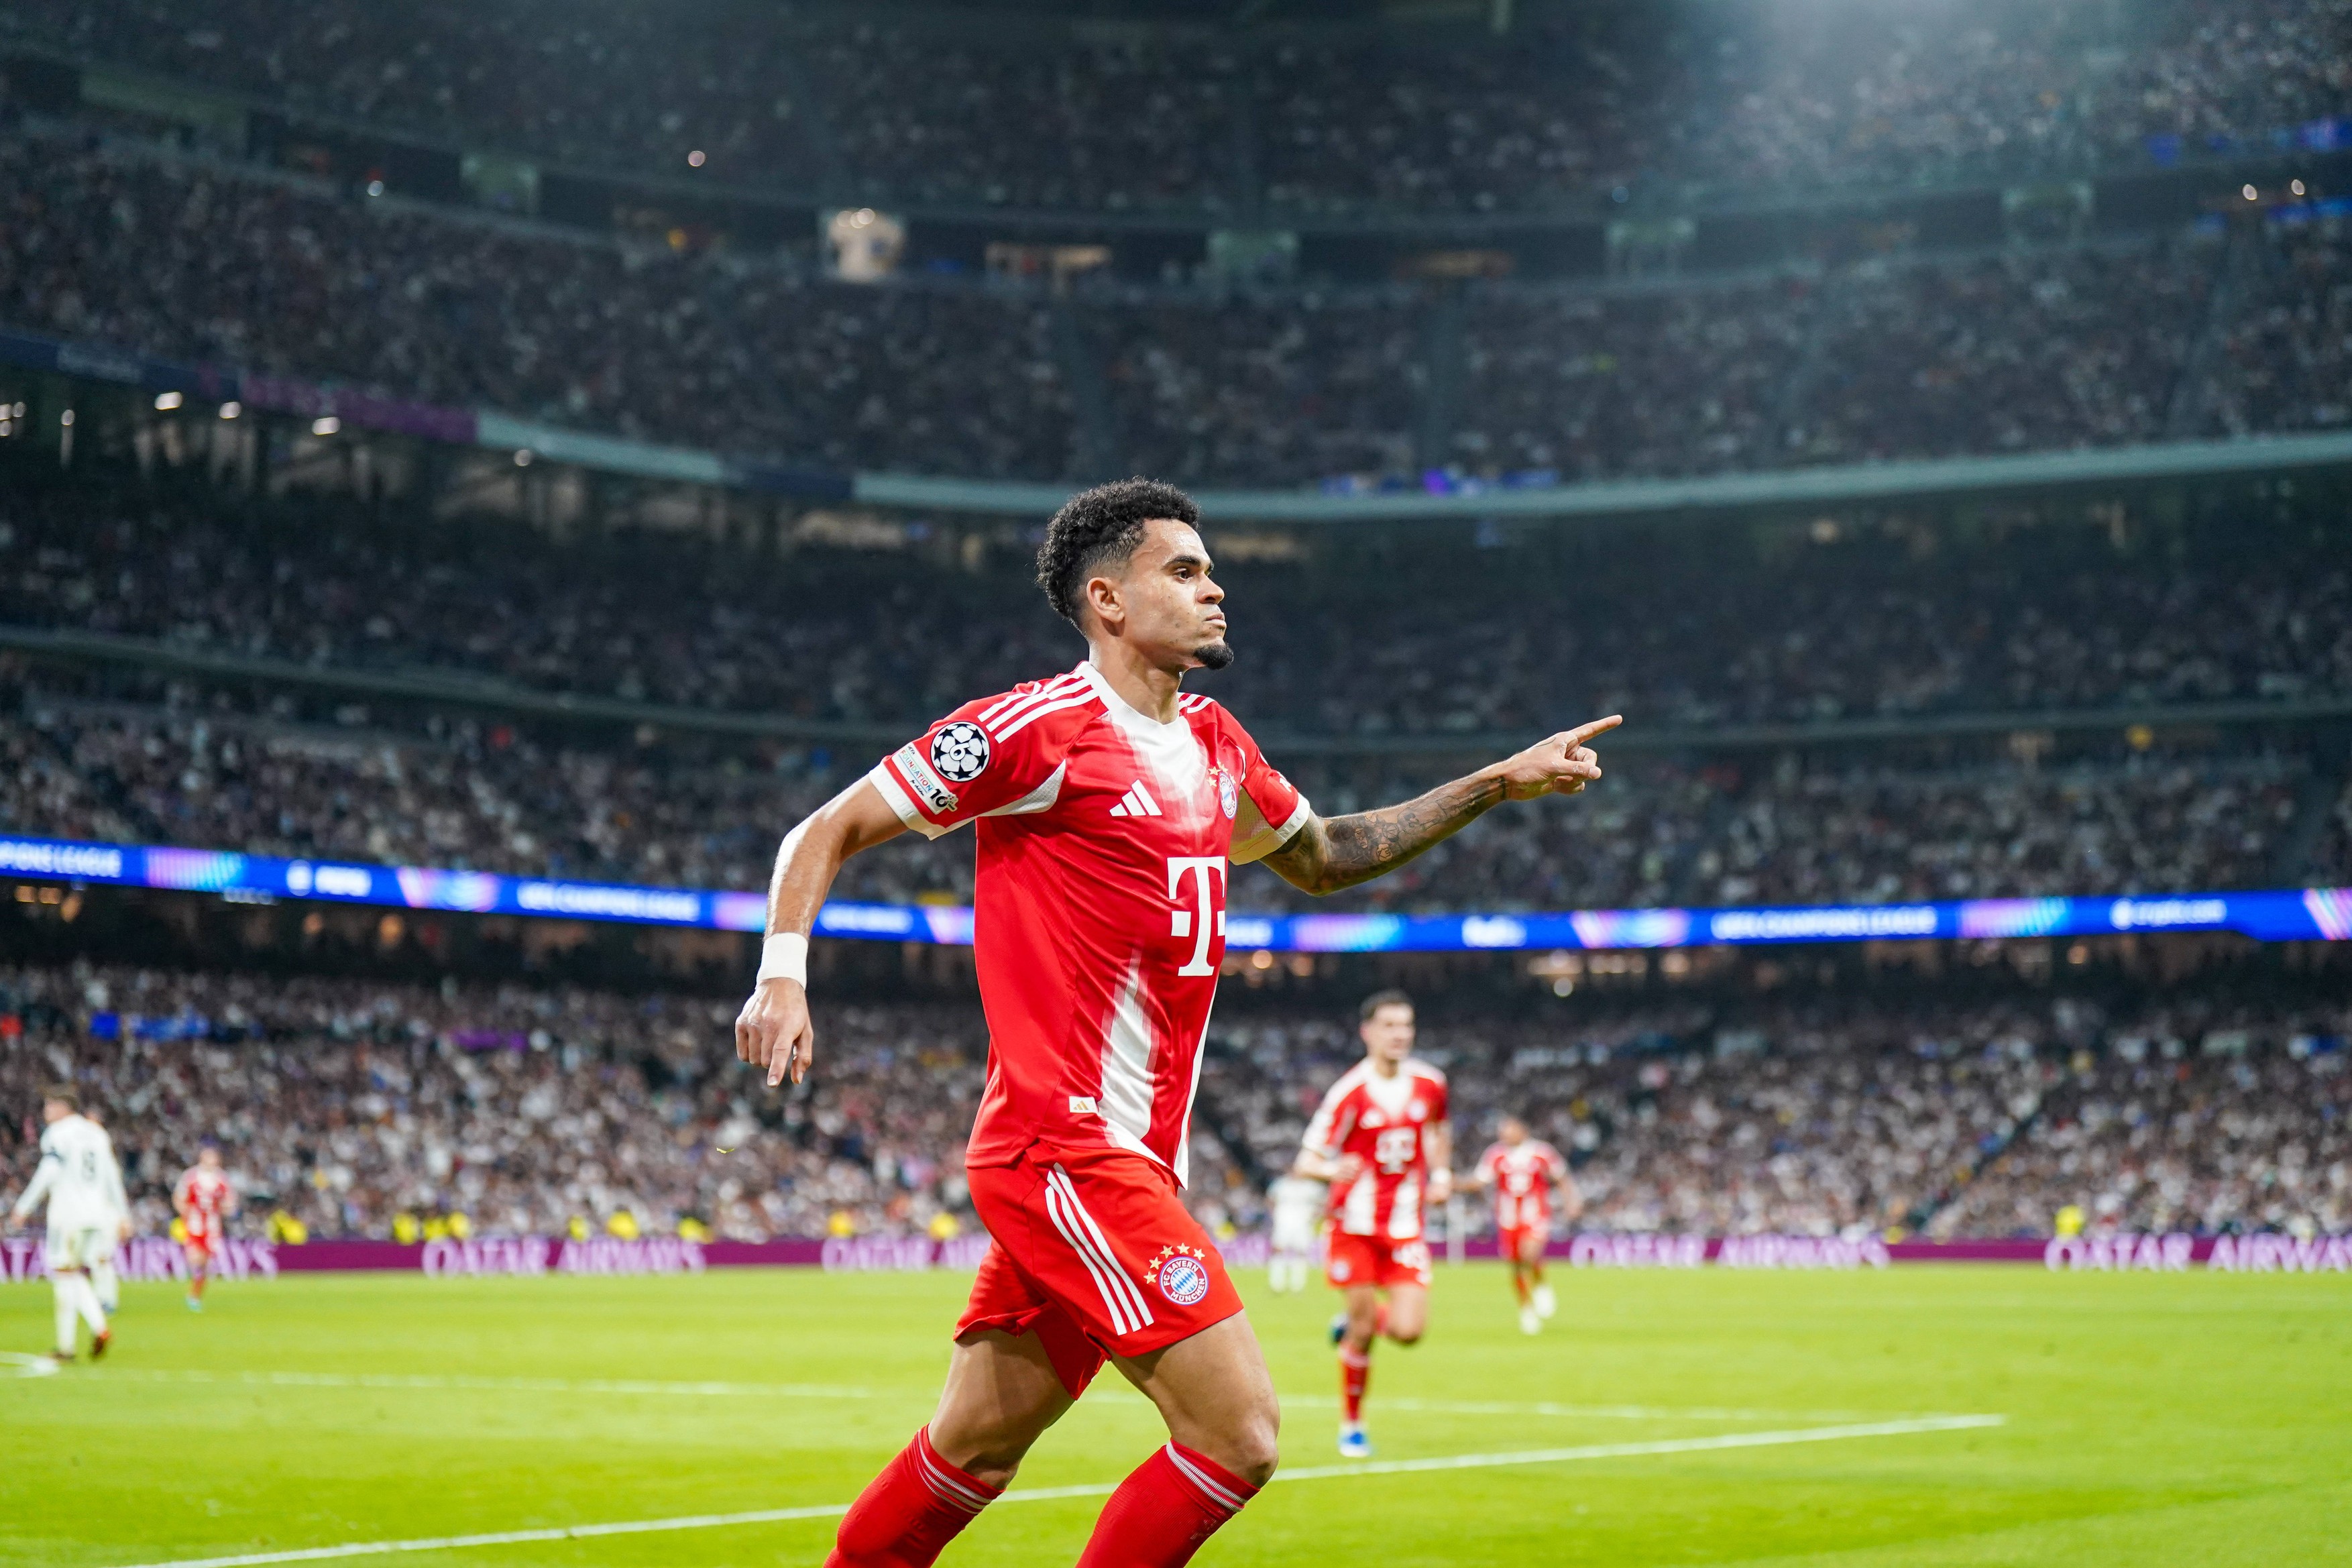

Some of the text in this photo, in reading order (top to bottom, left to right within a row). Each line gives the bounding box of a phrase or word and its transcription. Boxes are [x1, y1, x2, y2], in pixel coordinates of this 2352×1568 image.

[901, 750, 933, 791] FOUNDATION
[930, 788, 948, 807] 10
[1167, 856, 1226, 976] T
[2208, 1231, 2352, 1273] AIRWA
[1164, 1261, 1198, 1286] FC BAYERN
